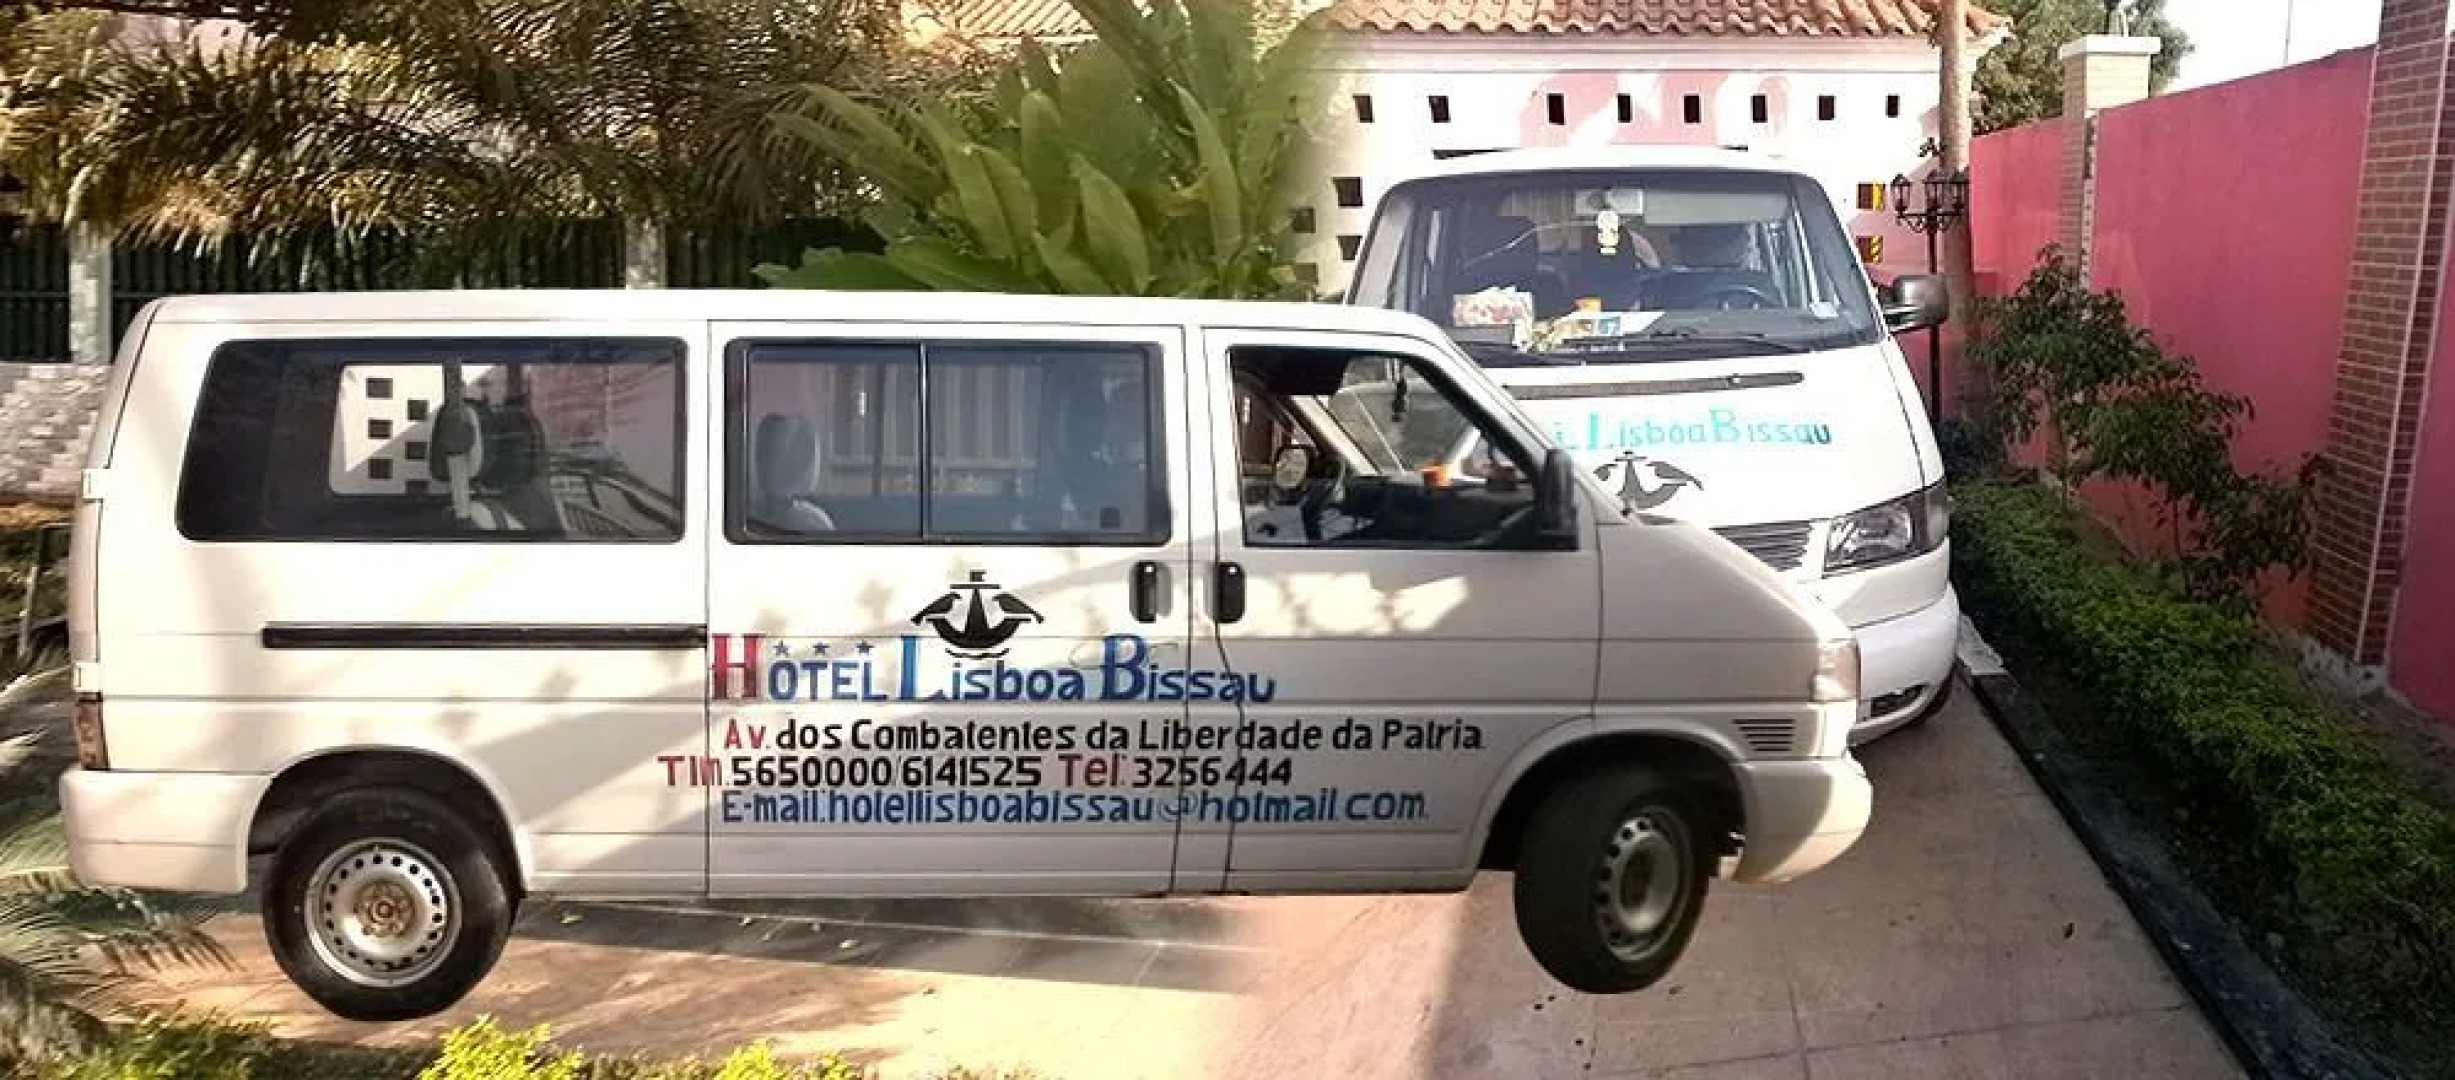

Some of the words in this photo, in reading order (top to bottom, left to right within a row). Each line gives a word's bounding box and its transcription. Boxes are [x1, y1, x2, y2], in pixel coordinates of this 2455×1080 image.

[900, 634, 1086, 701] Lisboa
[1100, 633, 1276, 702] Bissau
[776, 718, 843, 750] dos
[1086, 718, 1130, 750] da
[1139, 718, 1324, 750] Liberdade
[1332, 717, 1373, 750] da
[1131, 756, 1292, 788] 3256444
